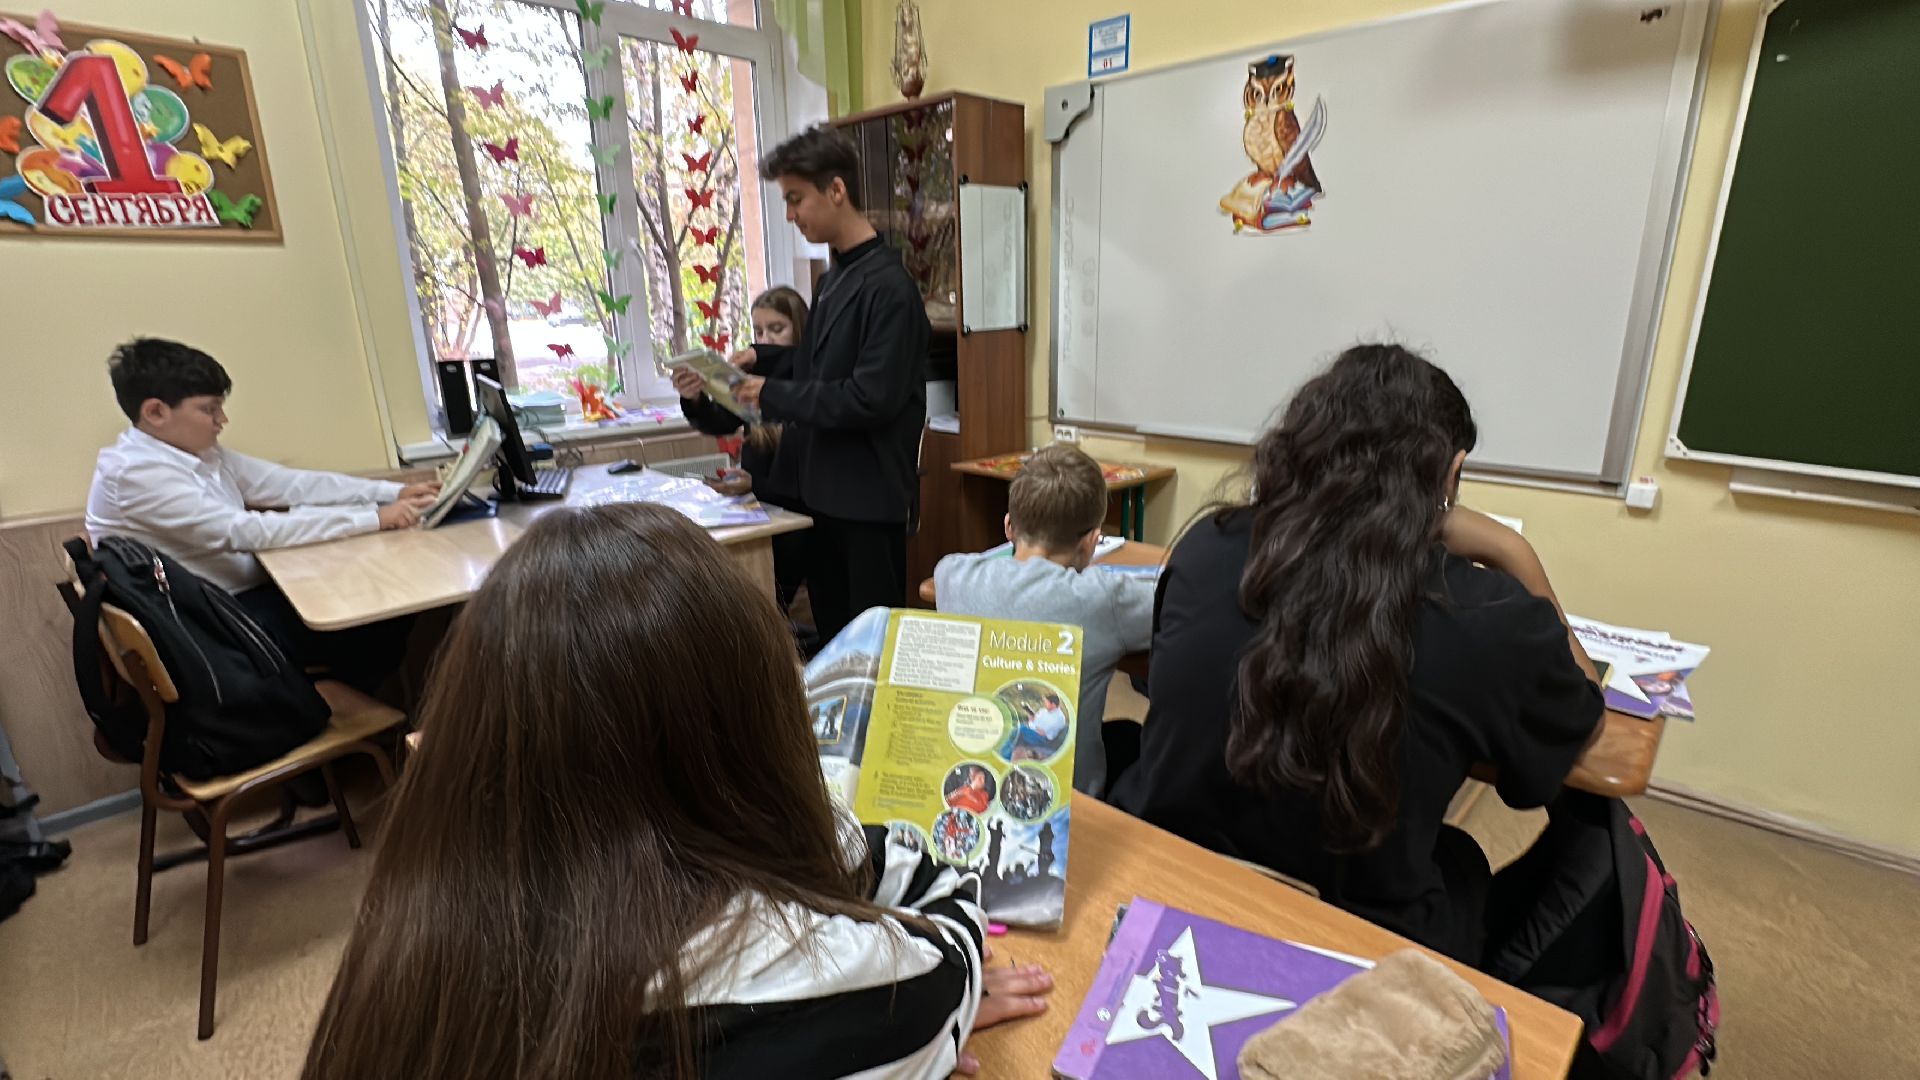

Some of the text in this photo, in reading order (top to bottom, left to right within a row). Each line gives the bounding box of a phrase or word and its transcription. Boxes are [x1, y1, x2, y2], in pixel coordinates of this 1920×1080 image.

[36, 55, 185, 195] 1
[48, 194, 214, 226] СЕНТЯБРЯ
[989, 630, 1074, 655] Module 2
[982, 655, 1077, 675] Culture & Stories
